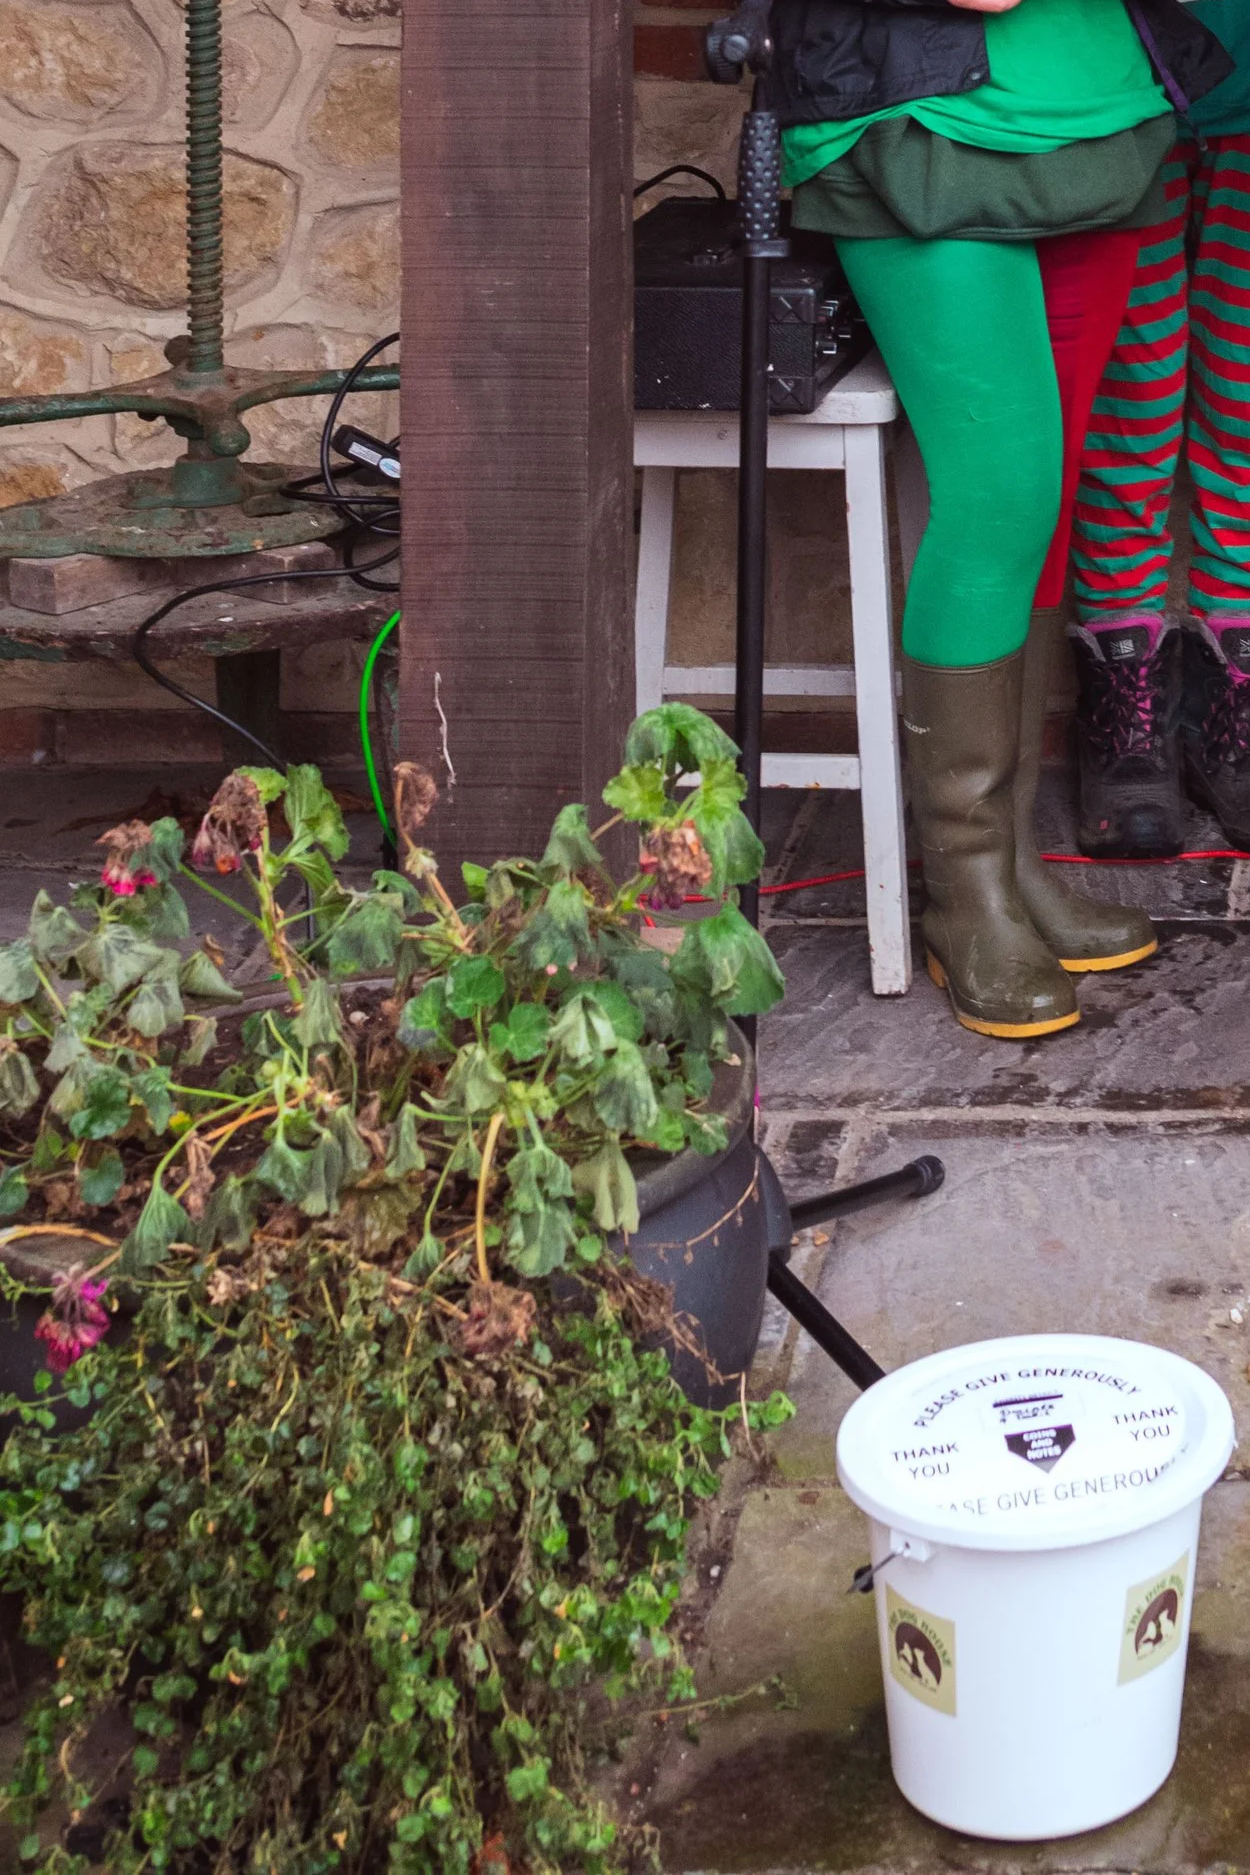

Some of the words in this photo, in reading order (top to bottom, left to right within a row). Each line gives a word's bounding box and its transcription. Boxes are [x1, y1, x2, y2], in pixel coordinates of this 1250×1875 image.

[913, 1389, 964, 1428] PLEASE
[965, 1372, 1011, 1391] GIVE
[1018, 1368, 1142, 1397] GENEROUSLY
[1112, 1405, 1179, 1425] THANK
[1130, 1424, 1171, 1442] YOU
[892, 1442, 960, 1463] THANK
[909, 1462, 950, 1480] YOU
[997, 1487, 1046, 1511] GIVE
